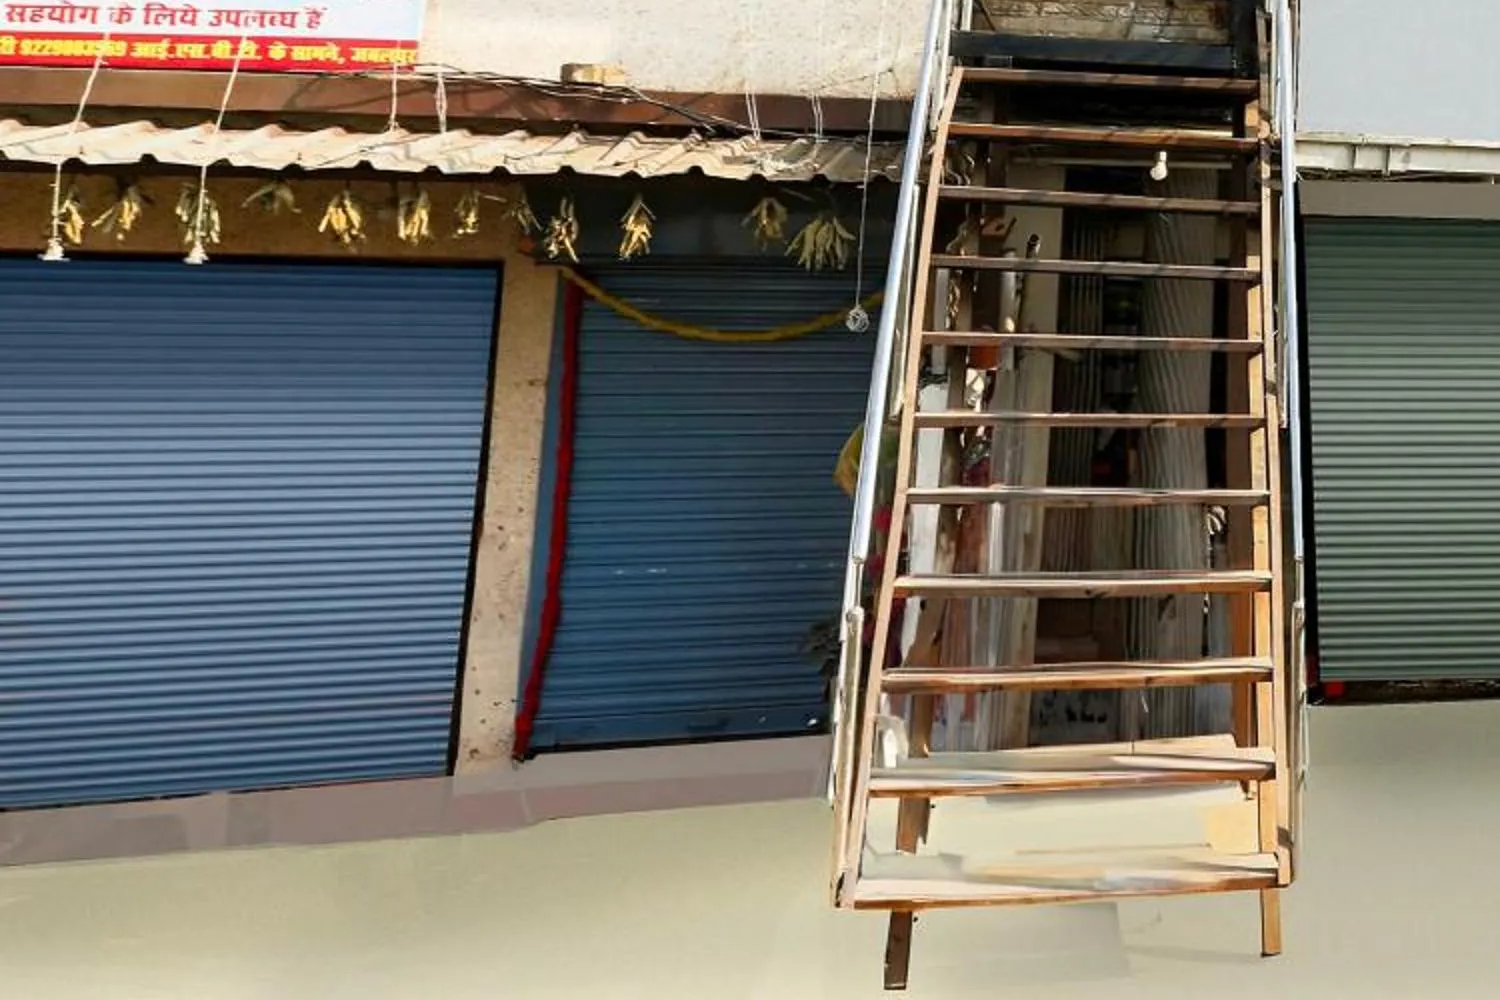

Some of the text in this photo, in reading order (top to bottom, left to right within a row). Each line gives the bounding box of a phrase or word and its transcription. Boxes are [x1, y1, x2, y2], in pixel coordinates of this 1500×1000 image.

[4, 1, 100, 25] सहयोग
[108, 3, 136, 25] के
[143, 2, 201, 26] लिये
